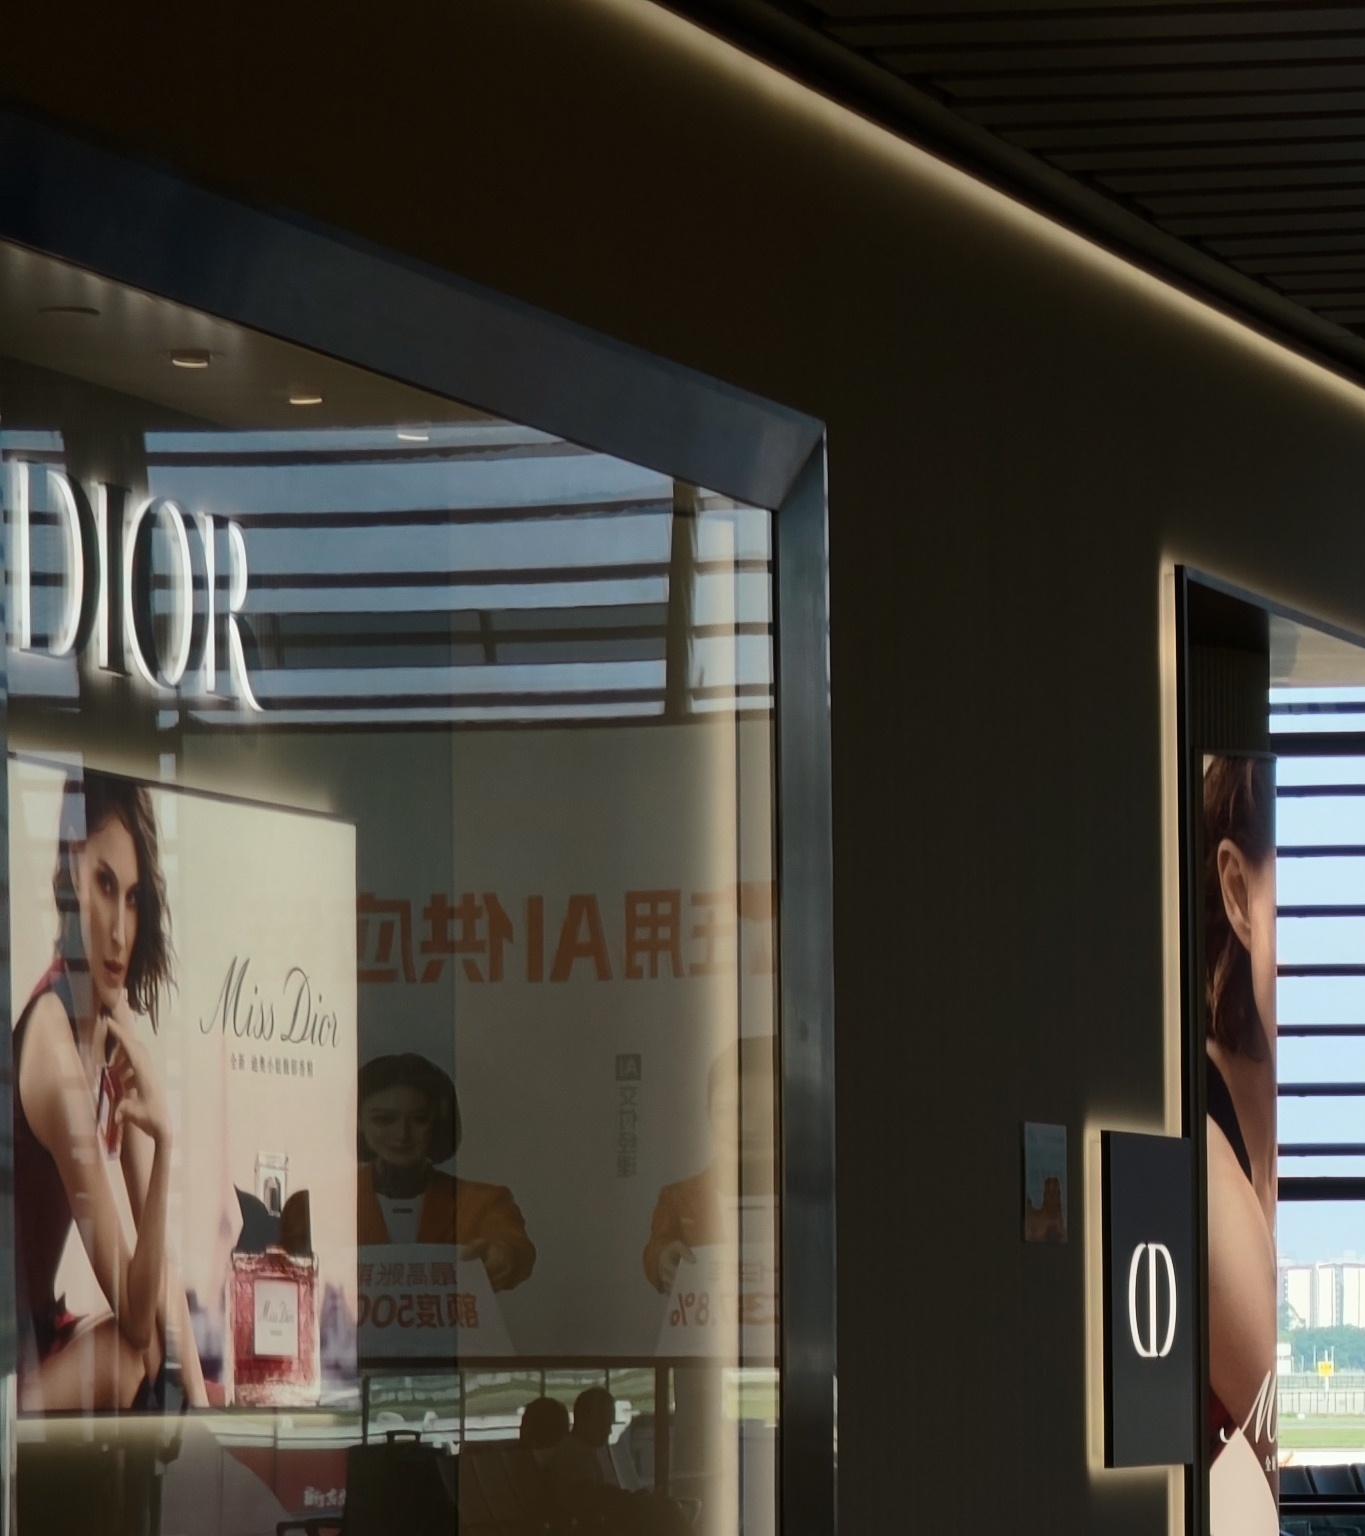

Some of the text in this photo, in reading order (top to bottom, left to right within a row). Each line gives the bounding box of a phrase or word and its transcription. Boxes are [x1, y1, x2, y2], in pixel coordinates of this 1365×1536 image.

[8, 456, 265, 712] DIOR
[199, 955, 337, 1048] Miss Dior
